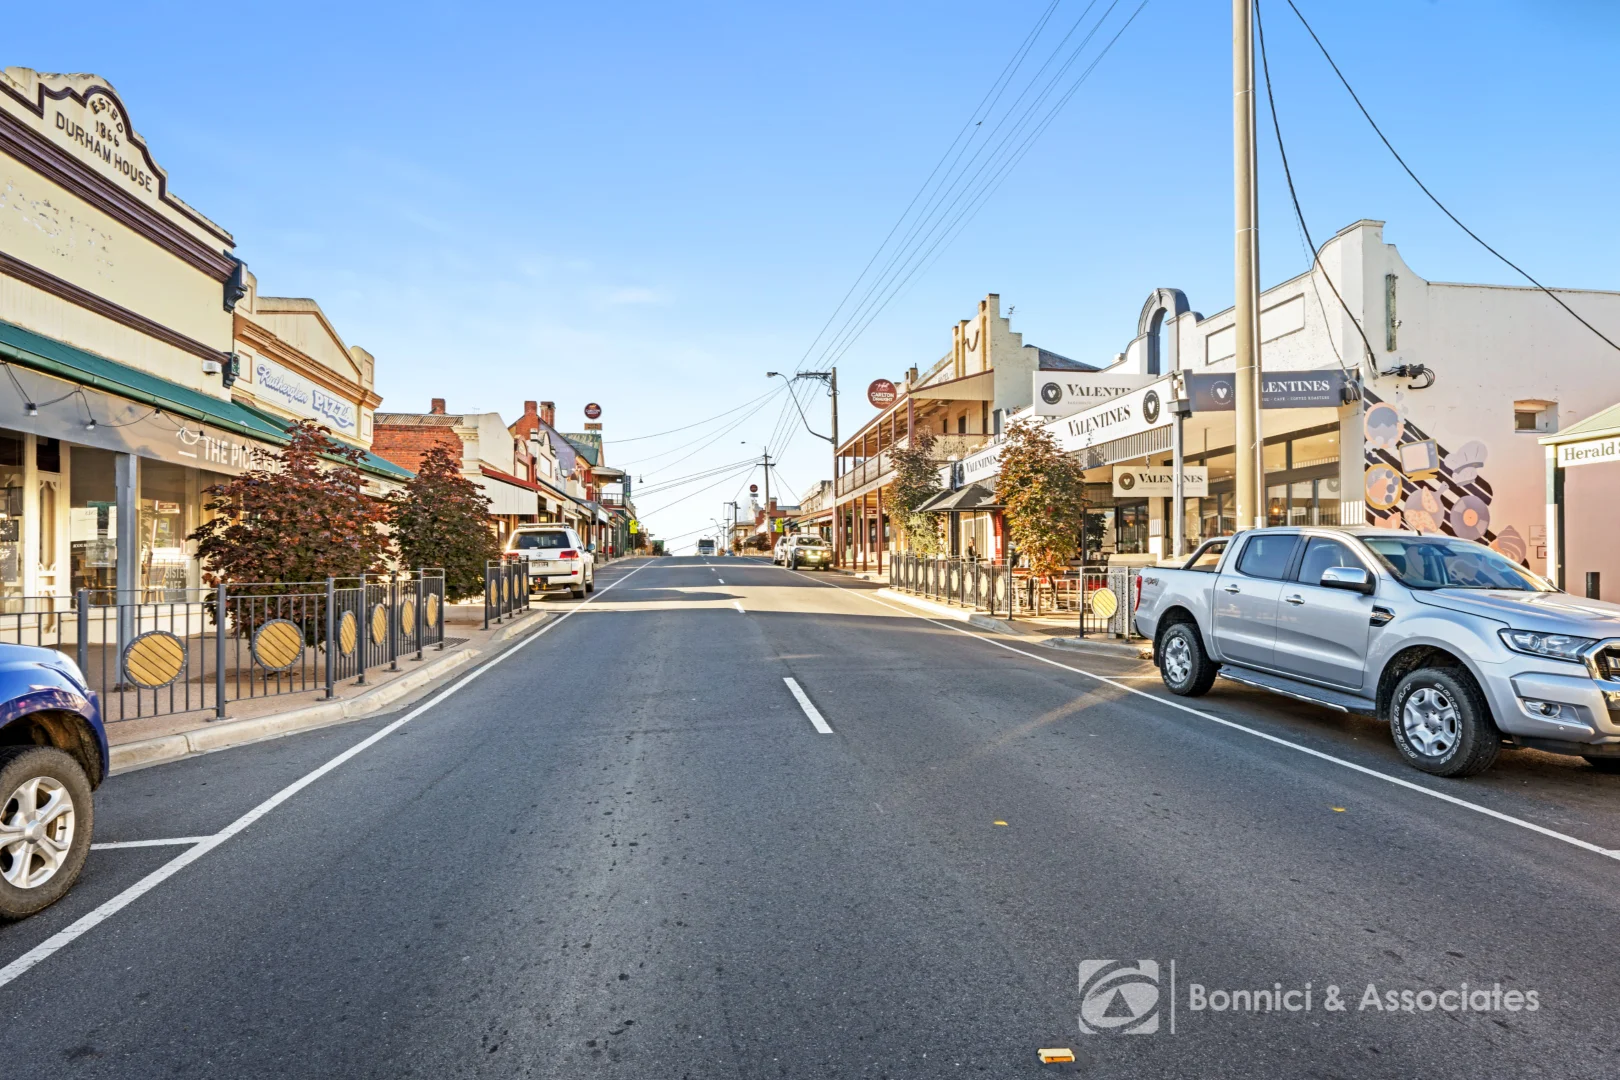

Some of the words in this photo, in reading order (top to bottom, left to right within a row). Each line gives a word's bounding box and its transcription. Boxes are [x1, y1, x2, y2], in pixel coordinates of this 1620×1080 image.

[95, 120, 120, 147] 1866
[55, 110, 112, 164] DURHAM
[113, 153, 153, 193] HOUSE
[312, 390, 355, 428] PIZZA
[1067, 404, 1132, 437] VALENTINES
[200, 434, 228, 466] THE
[1564, 441, 1616, 461] Herald
[1139, 473, 1204, 483] VALENNES
